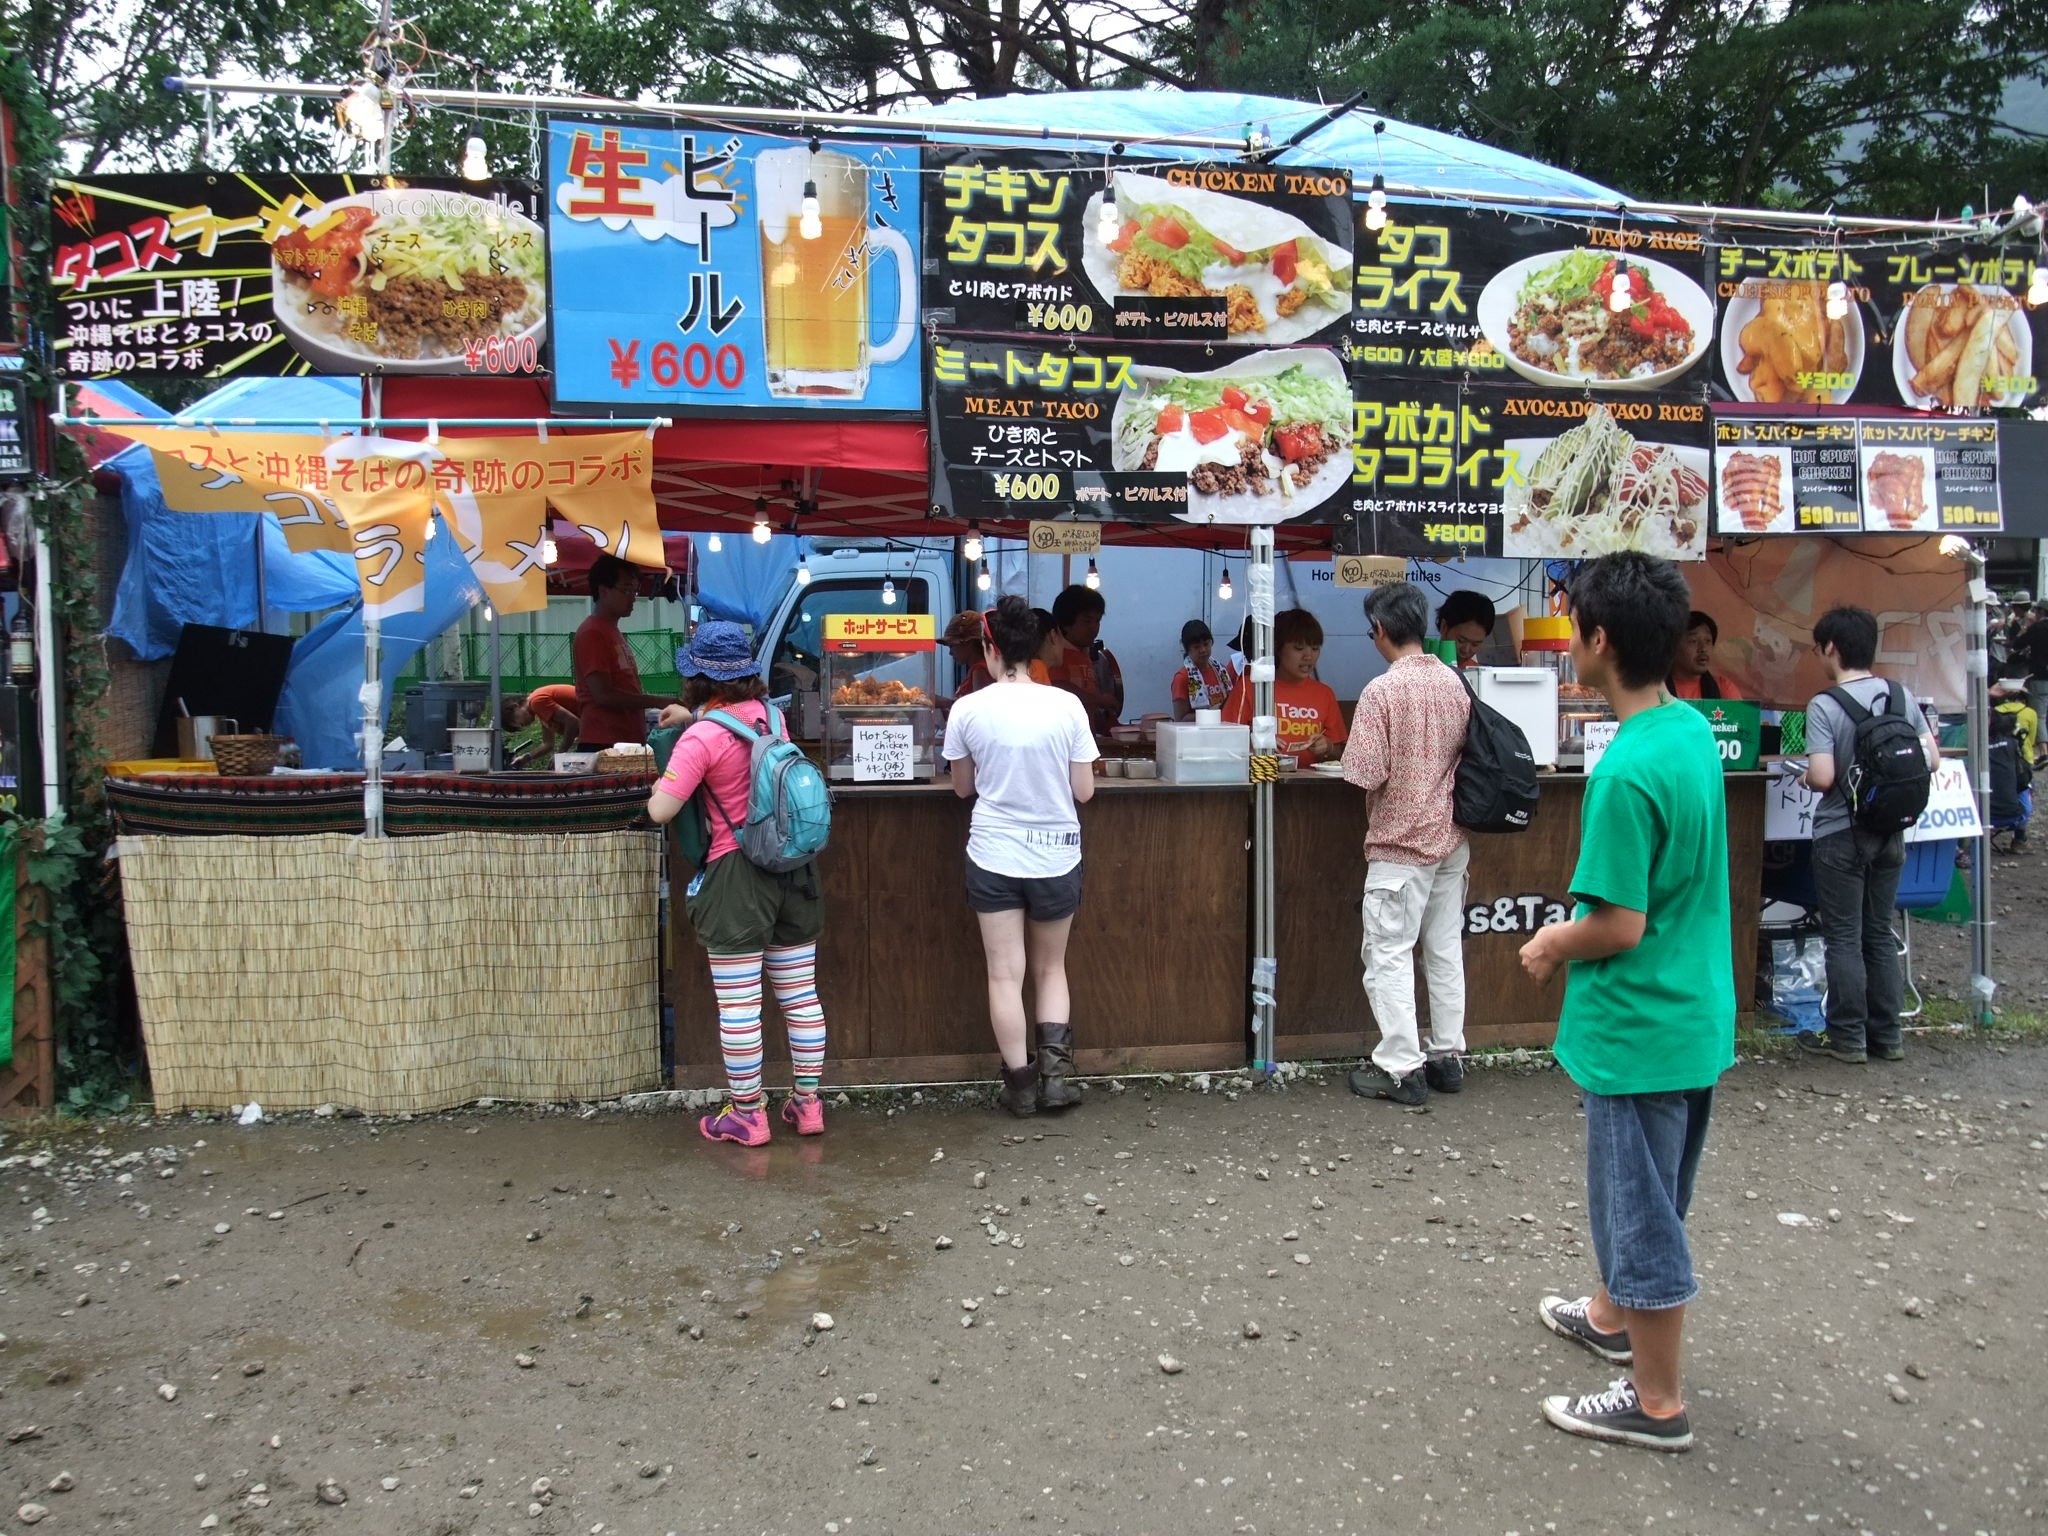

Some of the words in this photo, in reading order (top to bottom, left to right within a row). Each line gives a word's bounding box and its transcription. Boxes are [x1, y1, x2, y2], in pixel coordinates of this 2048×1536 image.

[944, 165, 1070, 214] チキン
[1167, 169, 1275, 194] CHICKEN
[1284, 175, 1347, 197] TACO
[567, 127, 656, 217] 生
[676, 134, 745, 336] ビール
[945, 216, 1068, 269] タコス
[1378, 220, 1449, 266] タコ
[1588, 227, 1643, 248] TACO
[1649, 229, 1702, 251] RICE
[949, 280, 1073, 301] とり肉とアボカド
[1357, 266, 1467, 313] ライス
[67, 298, 133, 321] ついに
[1027, 303, 1093, 331] ¥600
[68, 349, 204, 373] 奇跡のコラボ
[462, 335, 538, 373] ¥600
[607, 338, 746, 391] ¥600
[934, 345, 1139, 391] ミートタコス
[965, 396, 1034, 417] MEAT
[1042, 400, 1099, 420] TACO
[1503, 399, 1598, 422] AVOCADO
[1604, 402, 1652, 420] TACO
[1658, 405, 1704, 422] RICE
[1353, 400, 1490, 444] アボカド
[1717, 425, 1855, 441] ホットスパイシーチキン
[1863, 426, 1995, 441] ホットスパイシーチキン
[988, 425, 1058, 446] ひき肉と
[971, 446, 1093, 468] チーズとトマト
[1353, 447, 1526, 489] タコライス
[1793, 449, 1817, 464] HOT
[1820, 449, 1857, 464] SPICY
[1936, 450, 1960, 465] HOT
[1799, 465, 1851, 480] CHICKEN
[1942, 466, 1992, 481] CHICKEN
[994, 473, 1060, 501] ¥600
[1424, 523, 1486, 543] ¥800
[1405, 569, 1441, 582] rtillas
[844, 618, 917, 635] ホットサービス
[1277, 703, 1318, 719] Taco
[860, 730, 880, 740] Hot
[883, 730, 908, 742] Spicy
[1709, 723, 1738, 733] neken
[1716, 739, 1741, 760] 00
[1781, 790, 1813, 810] ドリ
[1918, 806, 1976, 829] 200円
[1461, 896, 1576, 933] s&Ta
